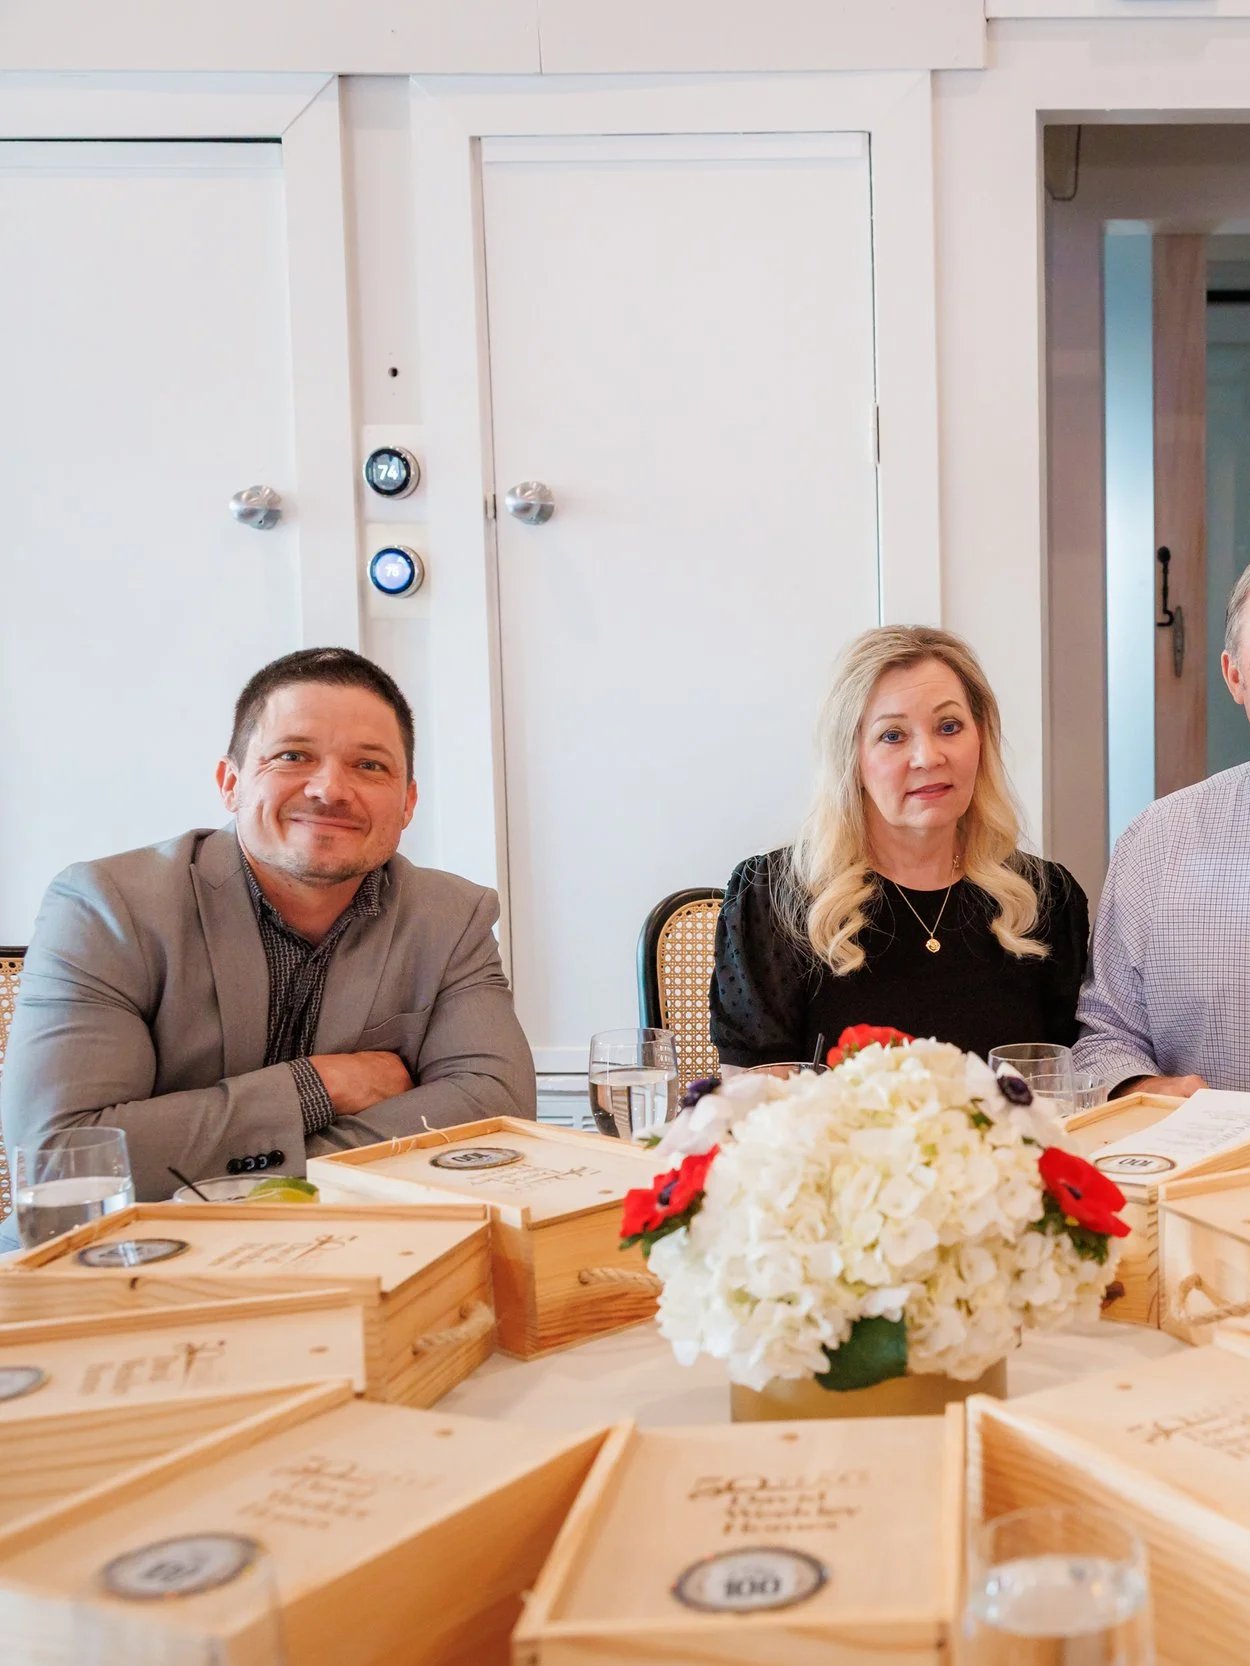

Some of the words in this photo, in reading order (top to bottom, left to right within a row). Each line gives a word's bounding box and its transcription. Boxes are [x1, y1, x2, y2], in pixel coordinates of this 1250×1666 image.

[378, 464, 398, 480] 74
[1119, 1157, 1153, 1168] 100
[723, 1577, 783, 1599] 100
